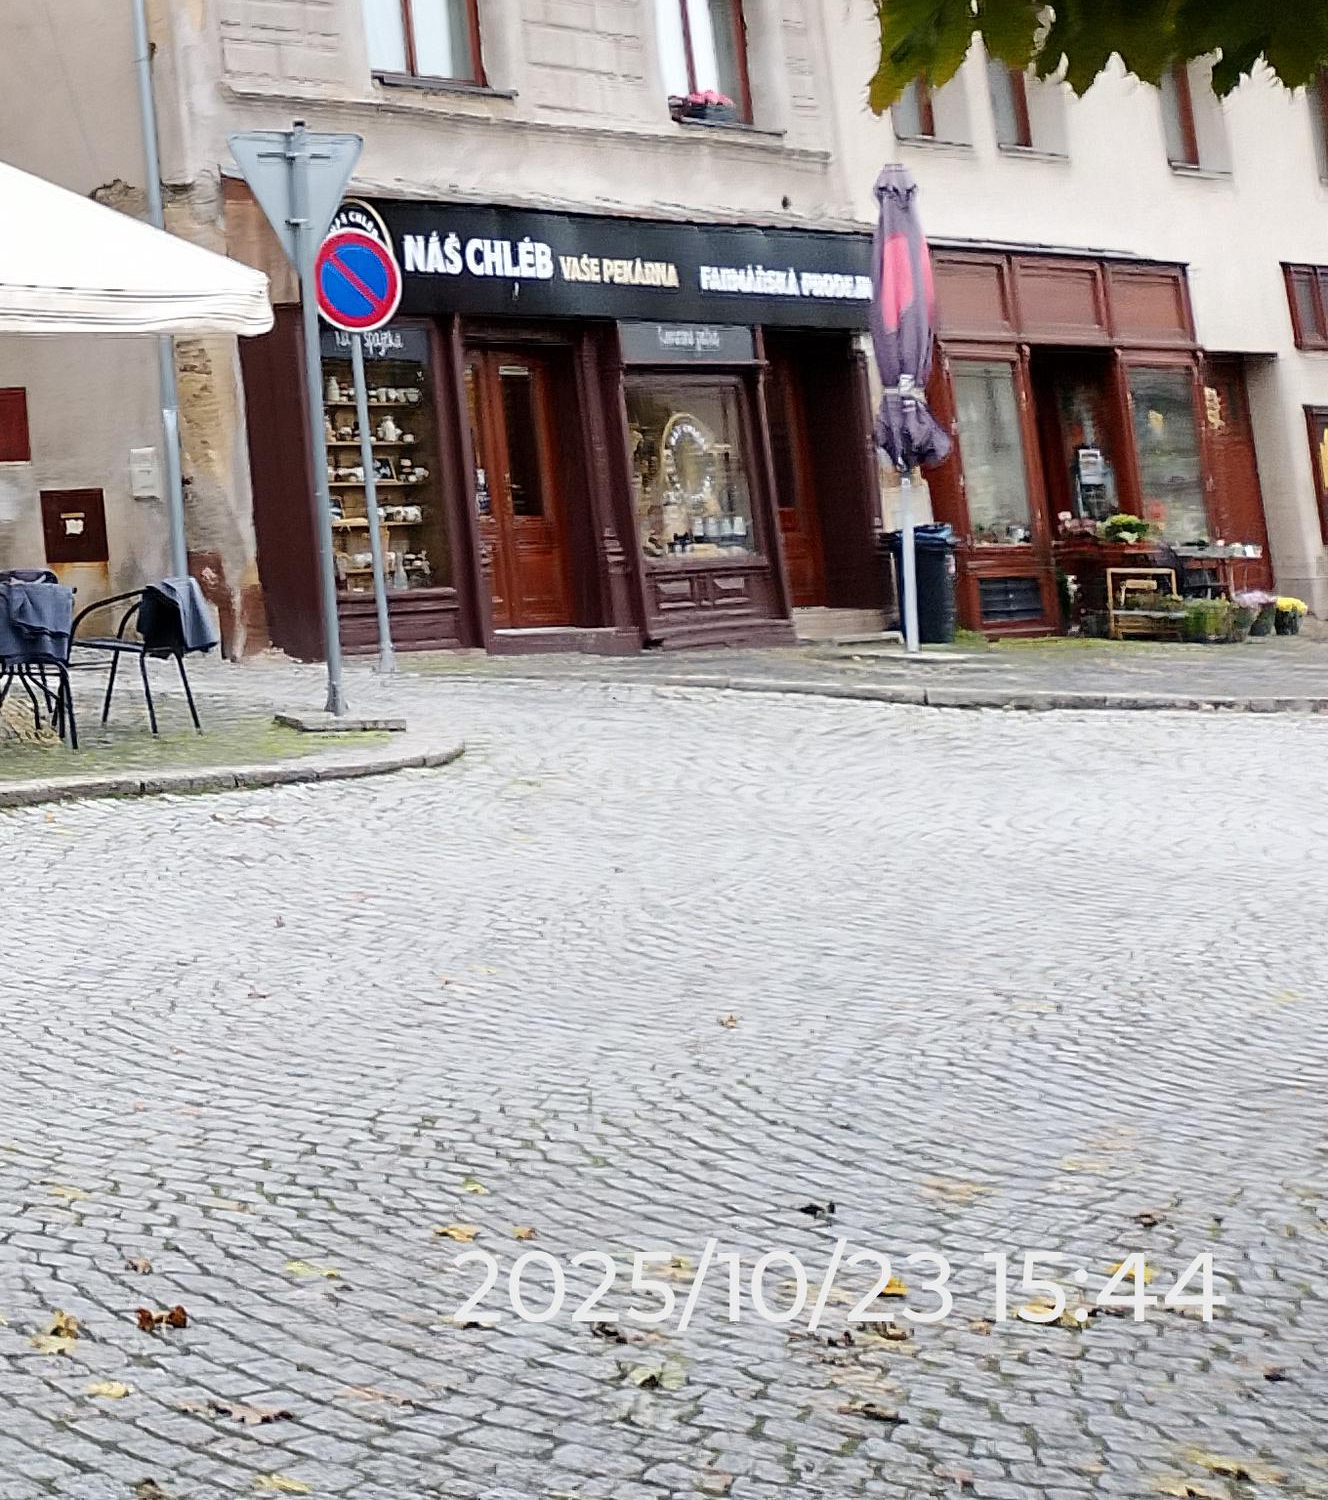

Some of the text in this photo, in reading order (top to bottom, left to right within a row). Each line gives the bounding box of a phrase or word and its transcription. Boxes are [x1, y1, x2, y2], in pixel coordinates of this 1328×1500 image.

[403, 231, 463, 275] NÁŠ
[465, 237, 554, 280] CHLÉB
[559, 254, 601, 283] VAŠE
[602, 257, 679, 288] PEKÁRNA
